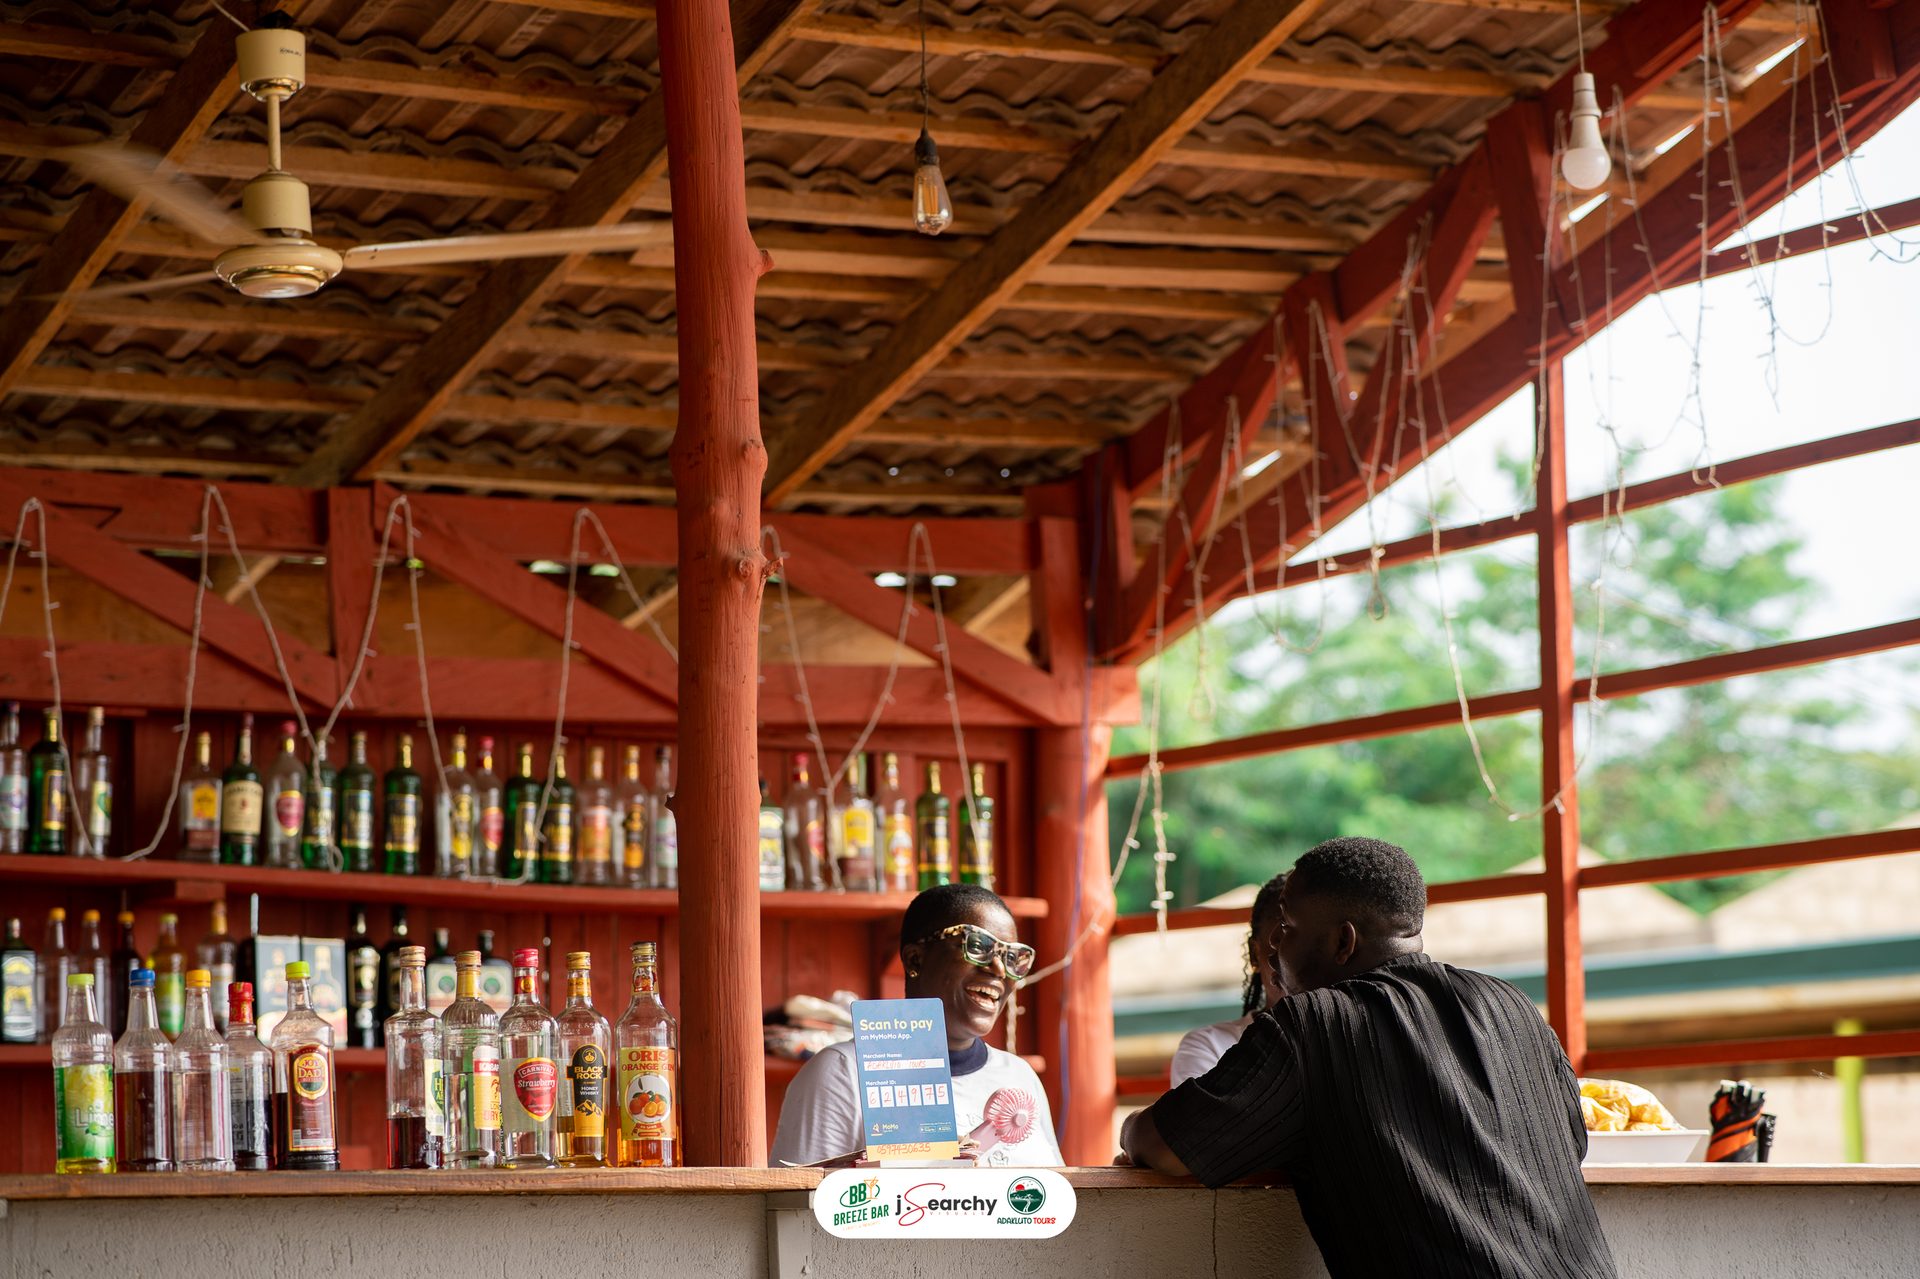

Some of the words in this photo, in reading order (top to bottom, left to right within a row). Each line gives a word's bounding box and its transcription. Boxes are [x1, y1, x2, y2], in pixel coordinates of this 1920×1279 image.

[860, 1019, 891, 1031] Scan
[894, 1018, 908, 1030] to
[910, 1019, 933, 1032] pay
[870, 1033, 897, 1041] MyMoMo
[898, 1032, 912, 1040] App.
[628, 1050, 668, 1062] ORIS
[521, 1065, 554, 1076] CARNIVAL
[621, 1063, 659, 1072] ORANGE
[298, 1068, 322, 1078] DAD
[576, 1072, 602, 1080] ROCK
[517, 1078, 556, 1088] Strawberry
[882, 1123, 899, 1131] MoMo
